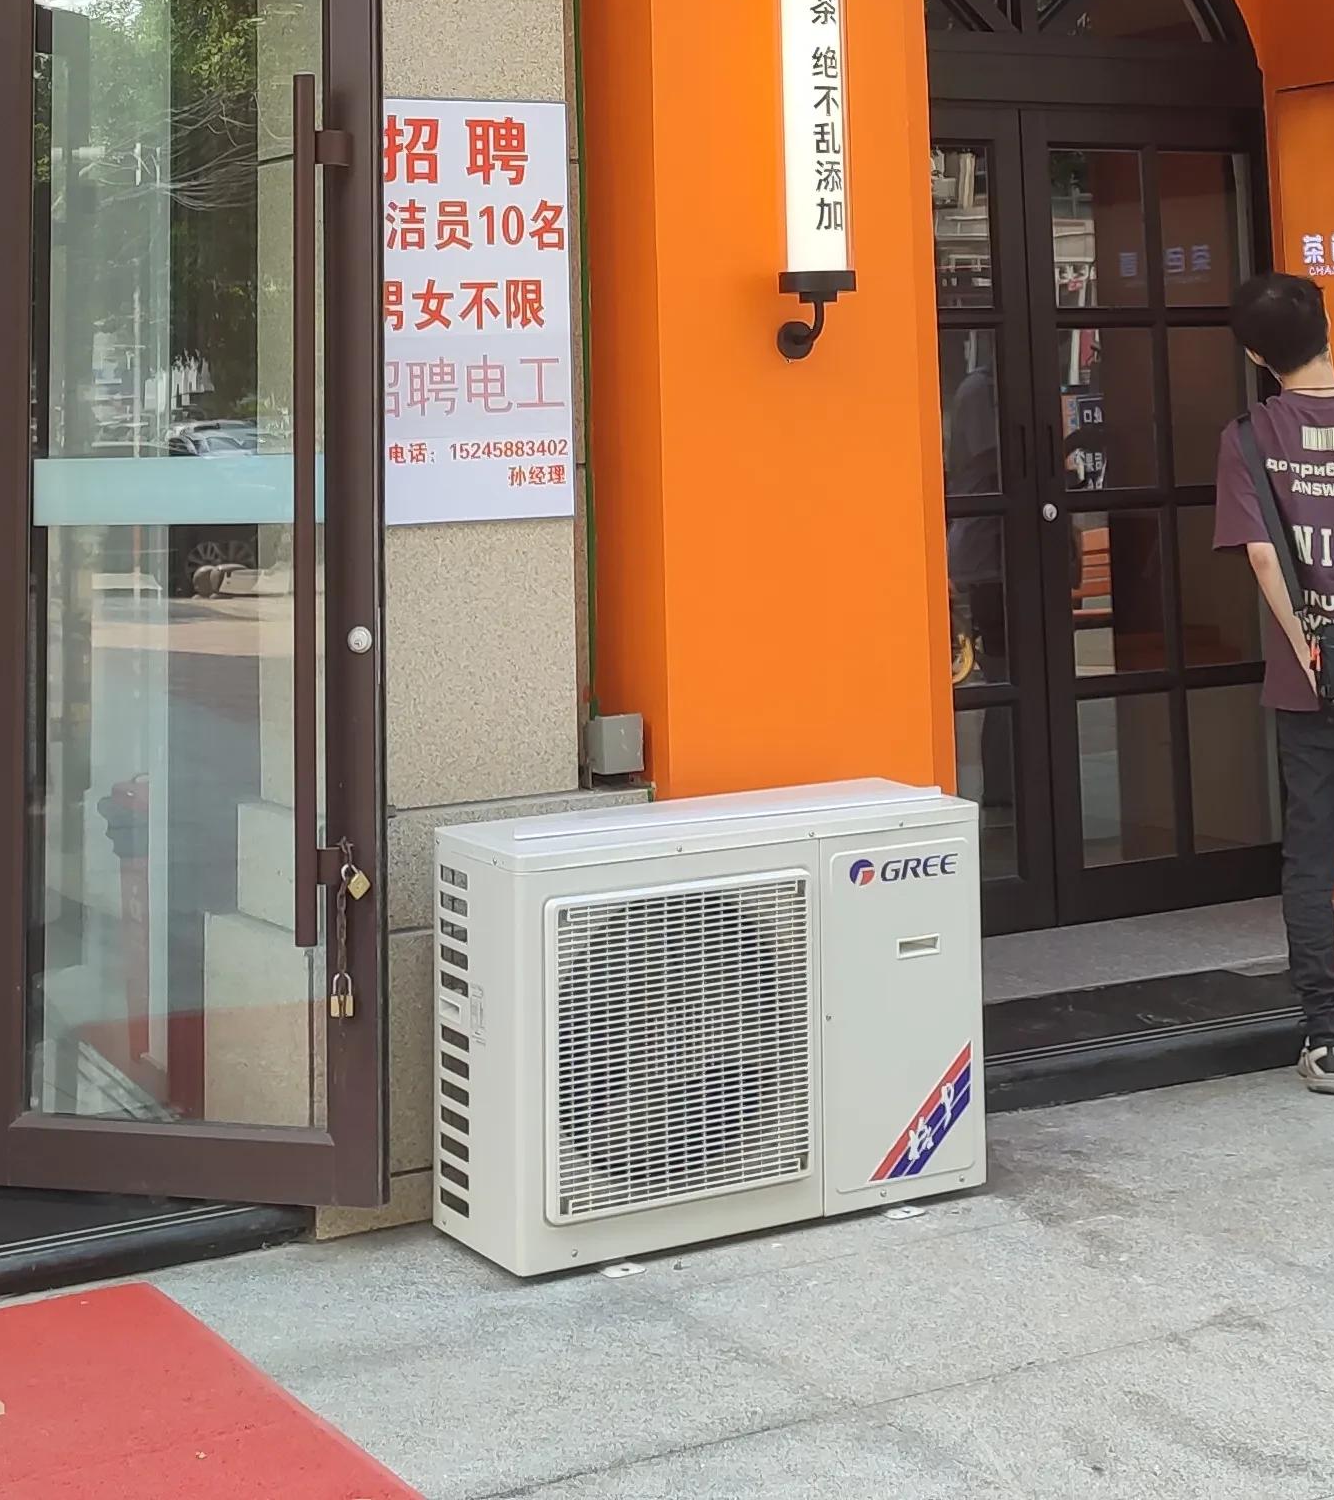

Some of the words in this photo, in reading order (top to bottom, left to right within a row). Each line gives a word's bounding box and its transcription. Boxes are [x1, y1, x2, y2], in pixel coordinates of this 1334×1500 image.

[384, 115, 529, 185] 招聘
[811, 45, 844, 232] 绝不乱添加
[386, 199, 566, 251] 洁员10名
[384, 278, 545, 331] 男女不限
[450, 439, 568, 461] 15245883402
[508, 465, 566, 487] 孙经理
[880, 853, 959, 882] GREE
